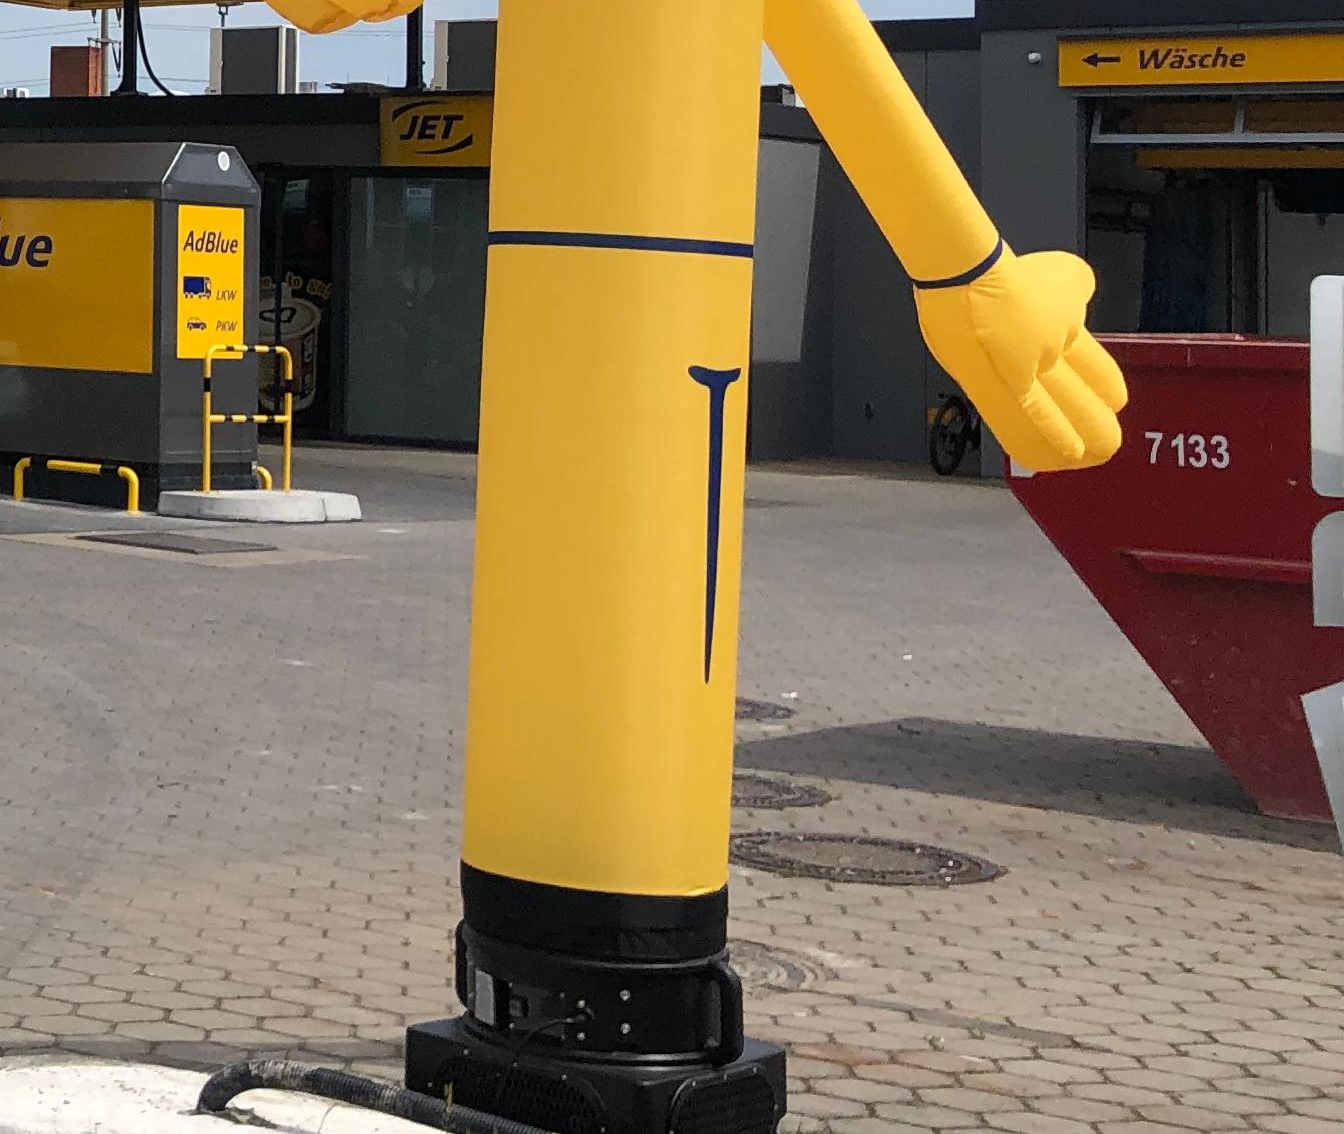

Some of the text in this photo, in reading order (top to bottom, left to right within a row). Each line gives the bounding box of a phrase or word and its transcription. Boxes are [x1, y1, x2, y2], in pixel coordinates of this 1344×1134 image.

[1139, 46, 1246, 70] Wäsche
[400, 115, 464, 140] JET
[183, 230, 239, 254] AdBlue
[1144, 431, 1231, 469] 7133
